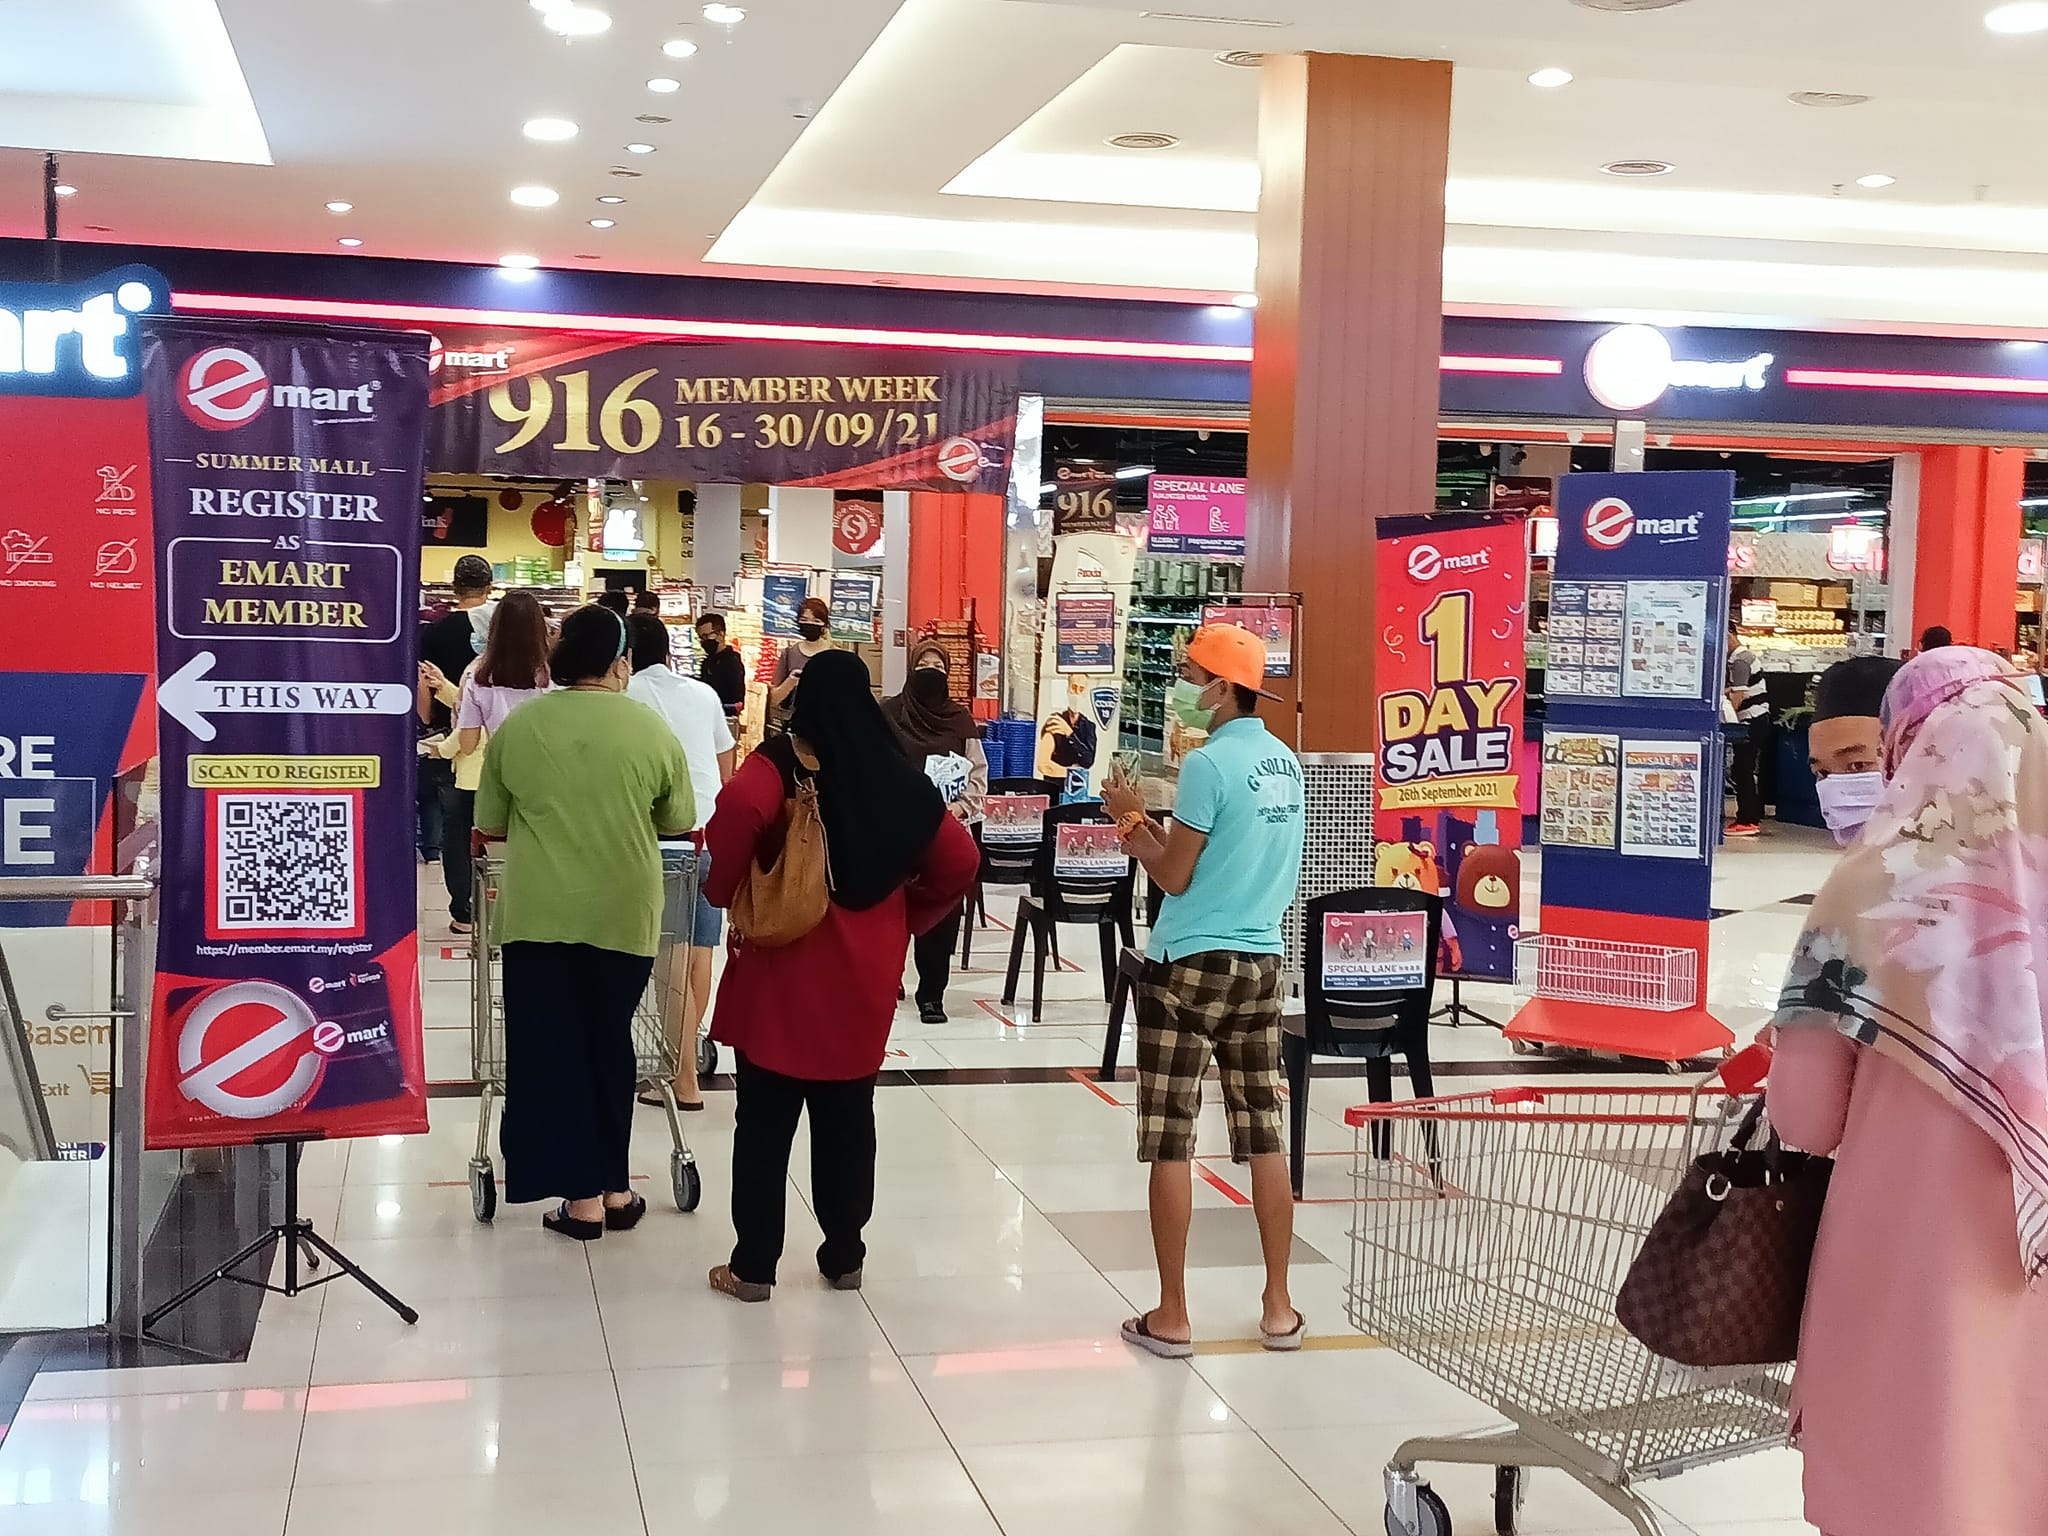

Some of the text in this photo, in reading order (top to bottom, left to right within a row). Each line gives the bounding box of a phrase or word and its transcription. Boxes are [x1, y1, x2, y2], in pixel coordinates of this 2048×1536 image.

[674, 375, 942, 405] MEMBER WEEK
[488, 367, 663, 454] 916
[674, 412, 723, 449] 16
[754, 408, 938, 451] 30/09/21
[195, 452, 377, 476] SUMMER MALL
[1153, 479, 1246, 494] SPECIAL LANE
[188, 487, 384, 523] REGISTER
[1057, 487, 1114, 520] 916
[273, 535, 301, 550] AS
[218, 558, 351, 590] EMART
[202, 597, 369, 629] MEMBER
[1424, 592, 1470, 686] 1
[213, 685, 383, 710] THIS WAY
[1382, 681, 1513, 742] DAY
[1385, 730, 1509, 782] SALE
[197, 764, 372, 780] SCAN TO REGISTER
[1398, 781, 1499, 804] 26th September 2021
[196, 942, 374, 956] https://member.emart.my/register
[1327, 965, 1370, 974] SPECIAL
